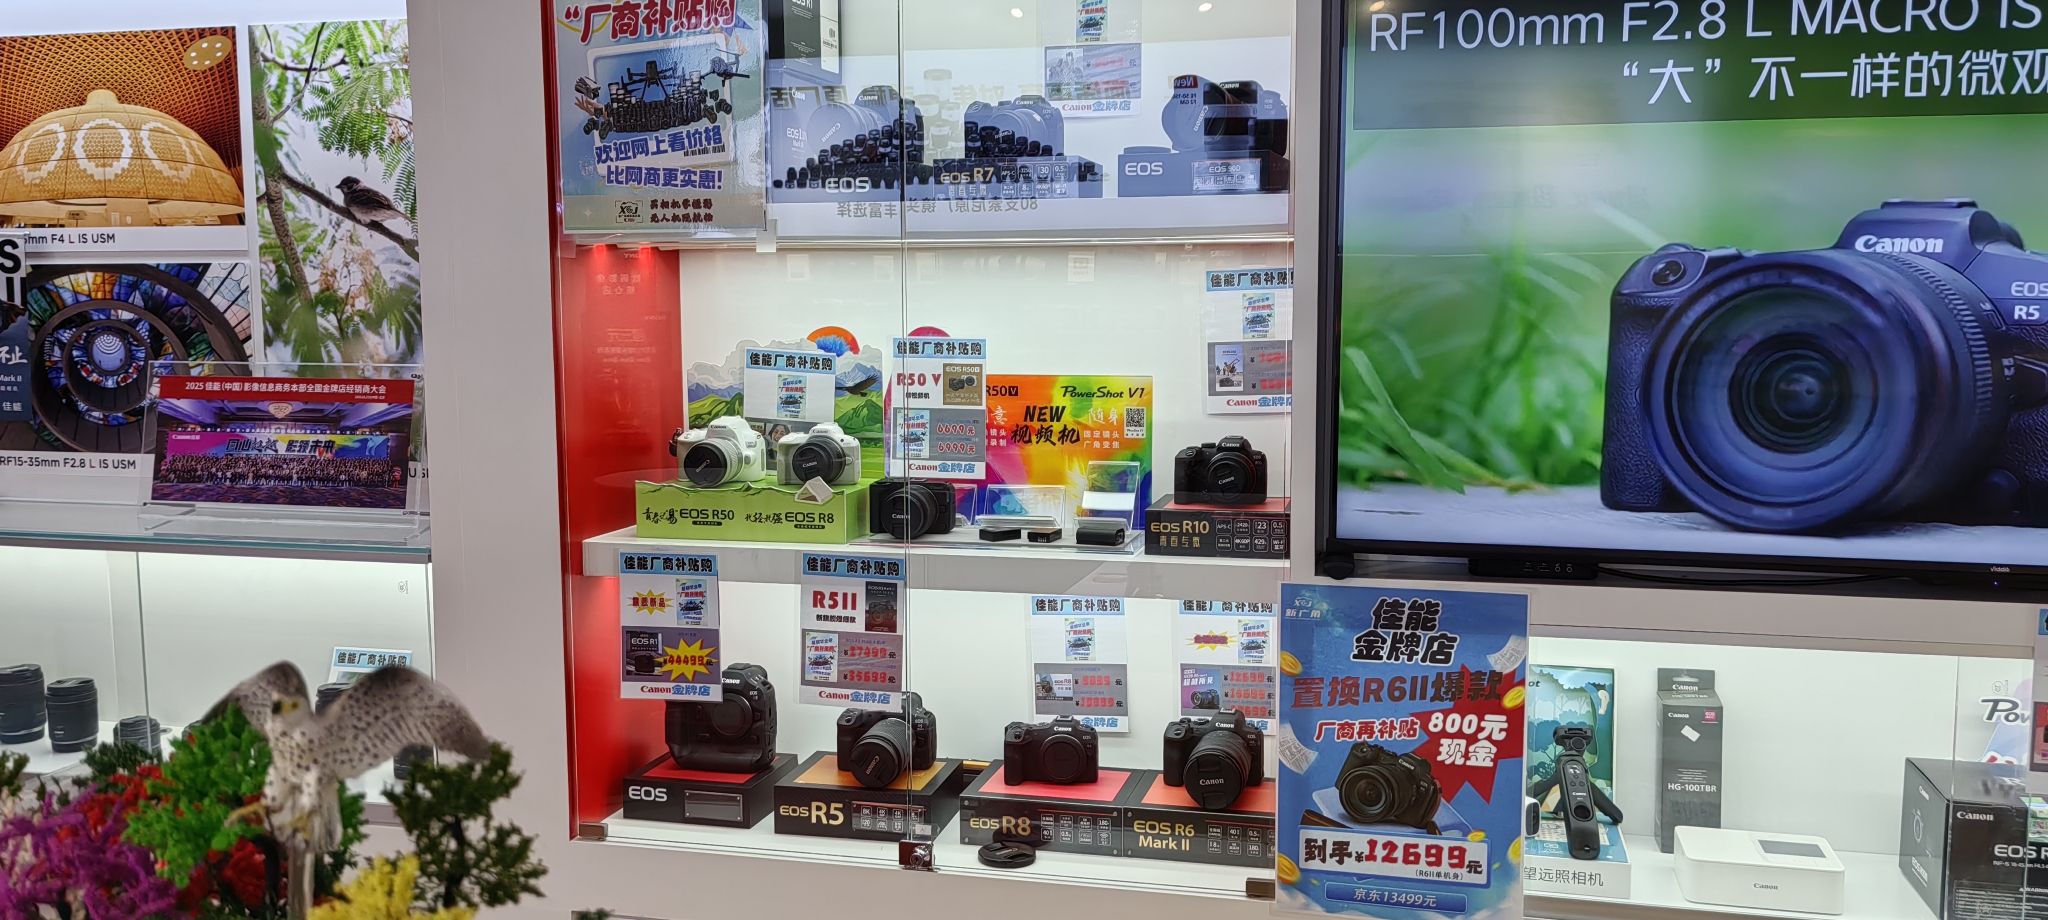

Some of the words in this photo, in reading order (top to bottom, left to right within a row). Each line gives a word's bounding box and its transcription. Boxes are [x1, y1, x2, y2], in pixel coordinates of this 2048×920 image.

[1370, 8, 1604, 52] RF100mm
[1621, 1, 1726, 41] F2.8
[1746, 0, 1772, 38] L
[1790, 0, 1977, 36] MACRO
[595, 125, 723, 164] 欢迎网上看价格
[940, 172, 970, 183] EOS
[973, 167, 994, 182] R7
[1125, 162, 1163, 176] EOS
[825, 177, 870, 193] EOS
[51, 233, 64, 244] F4
[68, 234, 75, 244] L
[78, 233, 88, 243] IS
[91, 233, 115, 243] USM
[1855, 234, 1943, 253] Canon
[1210, 271, 1293, 288] 佳能厂商补贴
[2014, 305, 2040, 320] R5
[896, 340, 982, 356] 佳能厂商补贴购
[749, 351, 834, 372] 佳能厂商补贴购
[185, 382, 204, 390] 2025
[896, 373, 927, 387] R50
[932, 373, 942, 387] V
[1061, 386, 1124, 399] PowerShot
[1129, 387, 1145, 399] V1
[1023, 405, 1067, 423] NEW
[1010, 424, 1081, 447] 视频机
[0, 456, 60, 467] RF15-35mm
[63, 458, 86, 468] F2.8
[89, 459, 96, 468] L
[99, 459, 109, 468] IS
[112, 459, 136, 469] USM
[1218, 475, 1235, 485] Canon
[679, 508, 709, 519] EOS
[711, 509, 735, 521] R50
[784, 511, 816, 523] EOS
[818, 513, 835, 524] R8
[1150, 522, 1180, 533] EOS
[1182, 520, 1210, 534] R10
[623, 555, 713, 573] 佳能厂商补贴购
[806, 557, 900, 576] 佳能厂商补贴购
[1035, 598, 1121, 612] 佳能厂商补贴购
[1372, 597, 1441, 632] 佳能
[631, 637, 649, 645] EOS
[1352, 631, 1458, 665] 金牌店
[1672, 684, 1698, 692] Canon
[1315, 717, 1420, 742] 厂商再补贴
[1428, 712, 1508, 740] 800元
[1437, 738, 1498, 767] 现金
[866, 755, 880, 775] Canon
[1199, 777, 1224, 786] Canon
[1667, 782, 1717, 793] HG-100TBR
[628, 785, 668, 802] EOS
[779, 805, 809, 817] EOS
[811, 802, 844, 825] R5
[1956, 811, 1994, 821] Canon
[969, 818, 1000, 830] EOS
[1002, 816, 1032, 837] R8
[1133, 820, 1172, 835] EOS
[1174, 824, 1195, 837] R6
[1138, 835, 1178, 850] Mark
[1181, 838, 1190, 851] II
[1993, 844, 2037, 859] EOS
[1524, 866, 1604, 887] 望远照相机
[1753, 882, 1779, 890] Canon
[1353, 887, 1438, 908] 京东13499元
